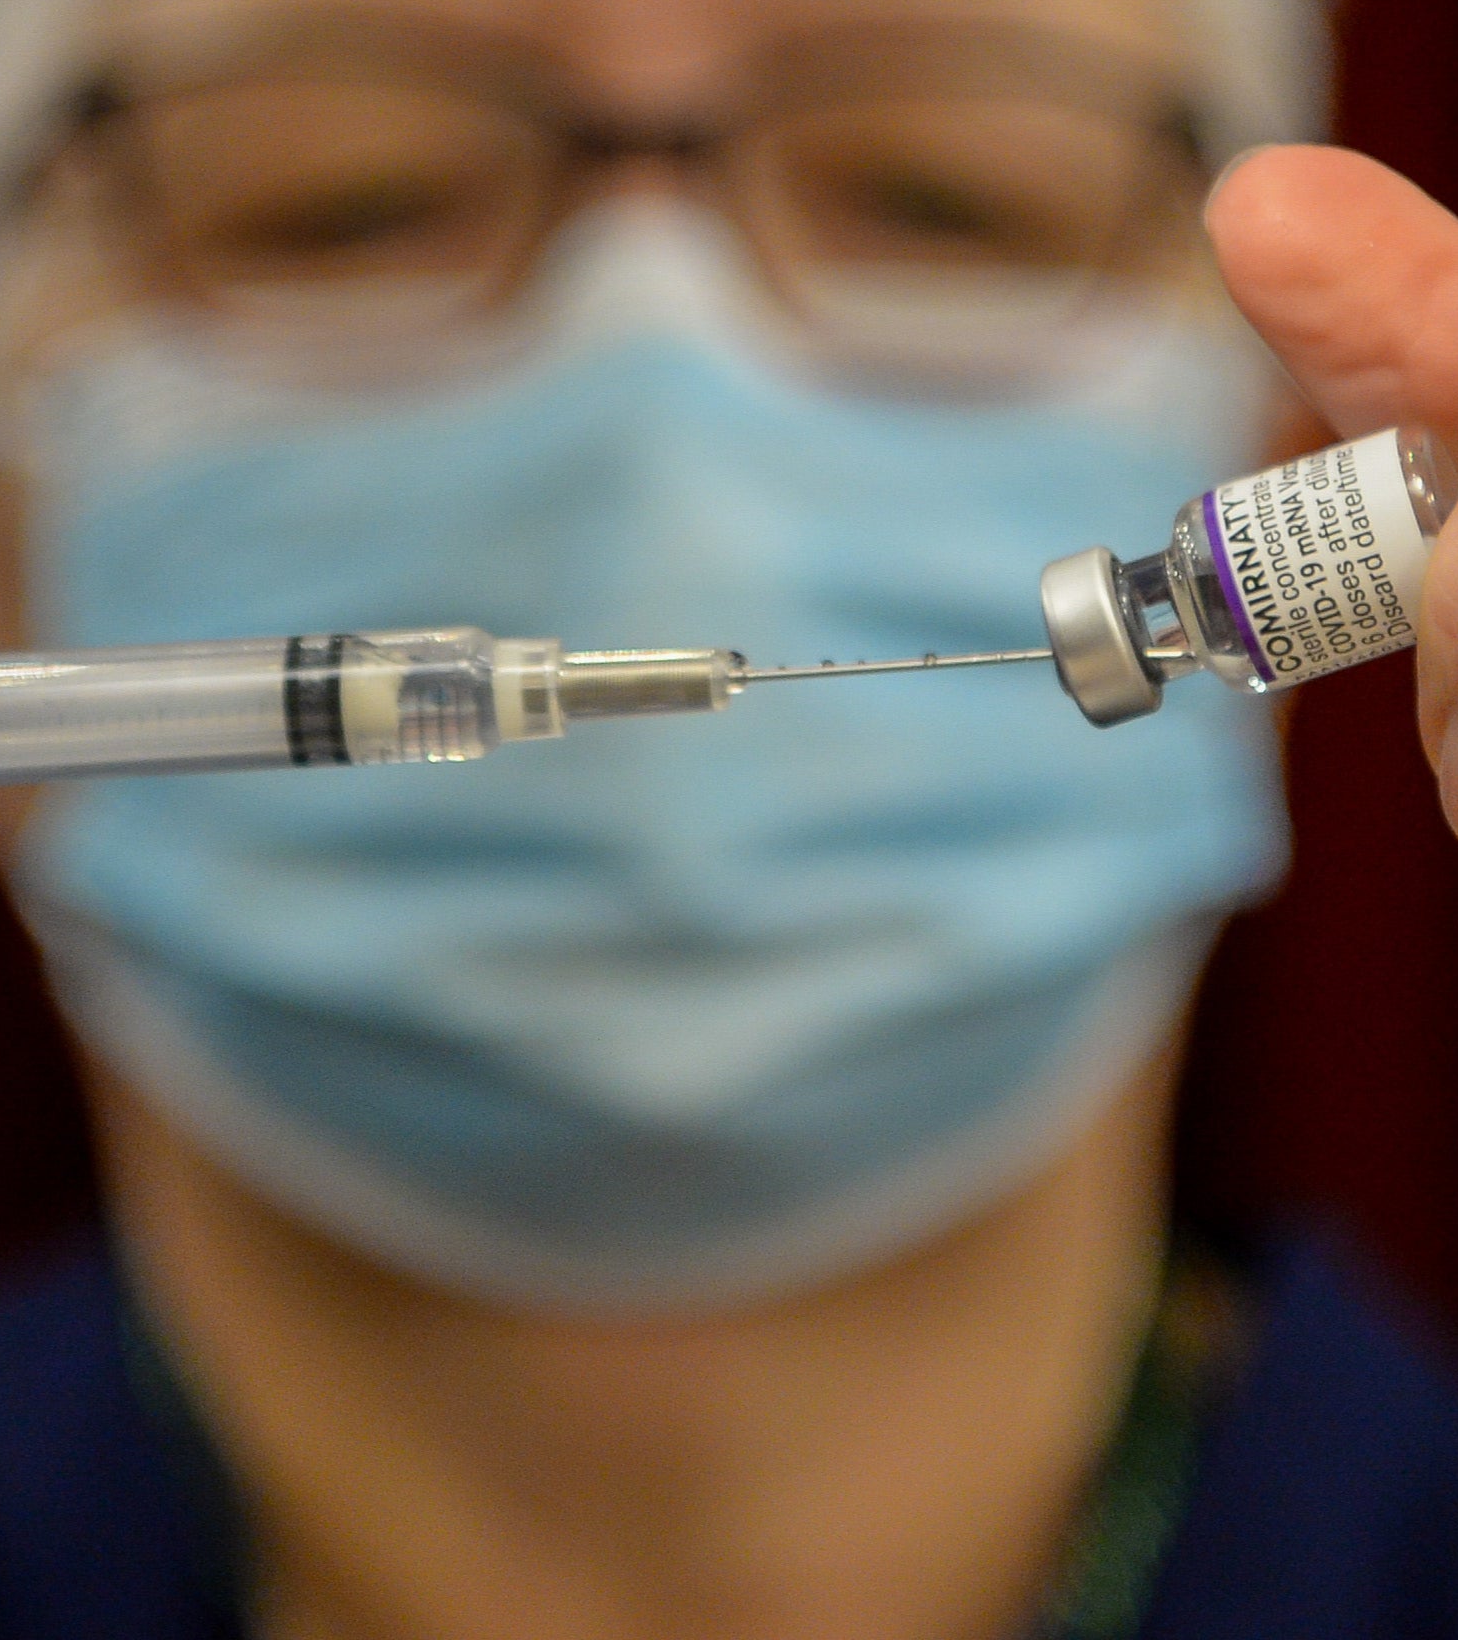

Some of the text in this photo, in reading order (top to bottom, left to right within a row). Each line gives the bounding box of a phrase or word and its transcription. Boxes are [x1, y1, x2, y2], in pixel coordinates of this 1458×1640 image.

[1281, 491, 1317, 556] mRNA
[1316, 498, 1347, 553] after
[1300, 562, 1356, 655] COVID-19
[1337, 560, 1377, 629] doses
[1357, 554, 1412, 637] Discard
[1288, 606, 1329, 663] sterile
[1361, 633, 1385, 646] 6
